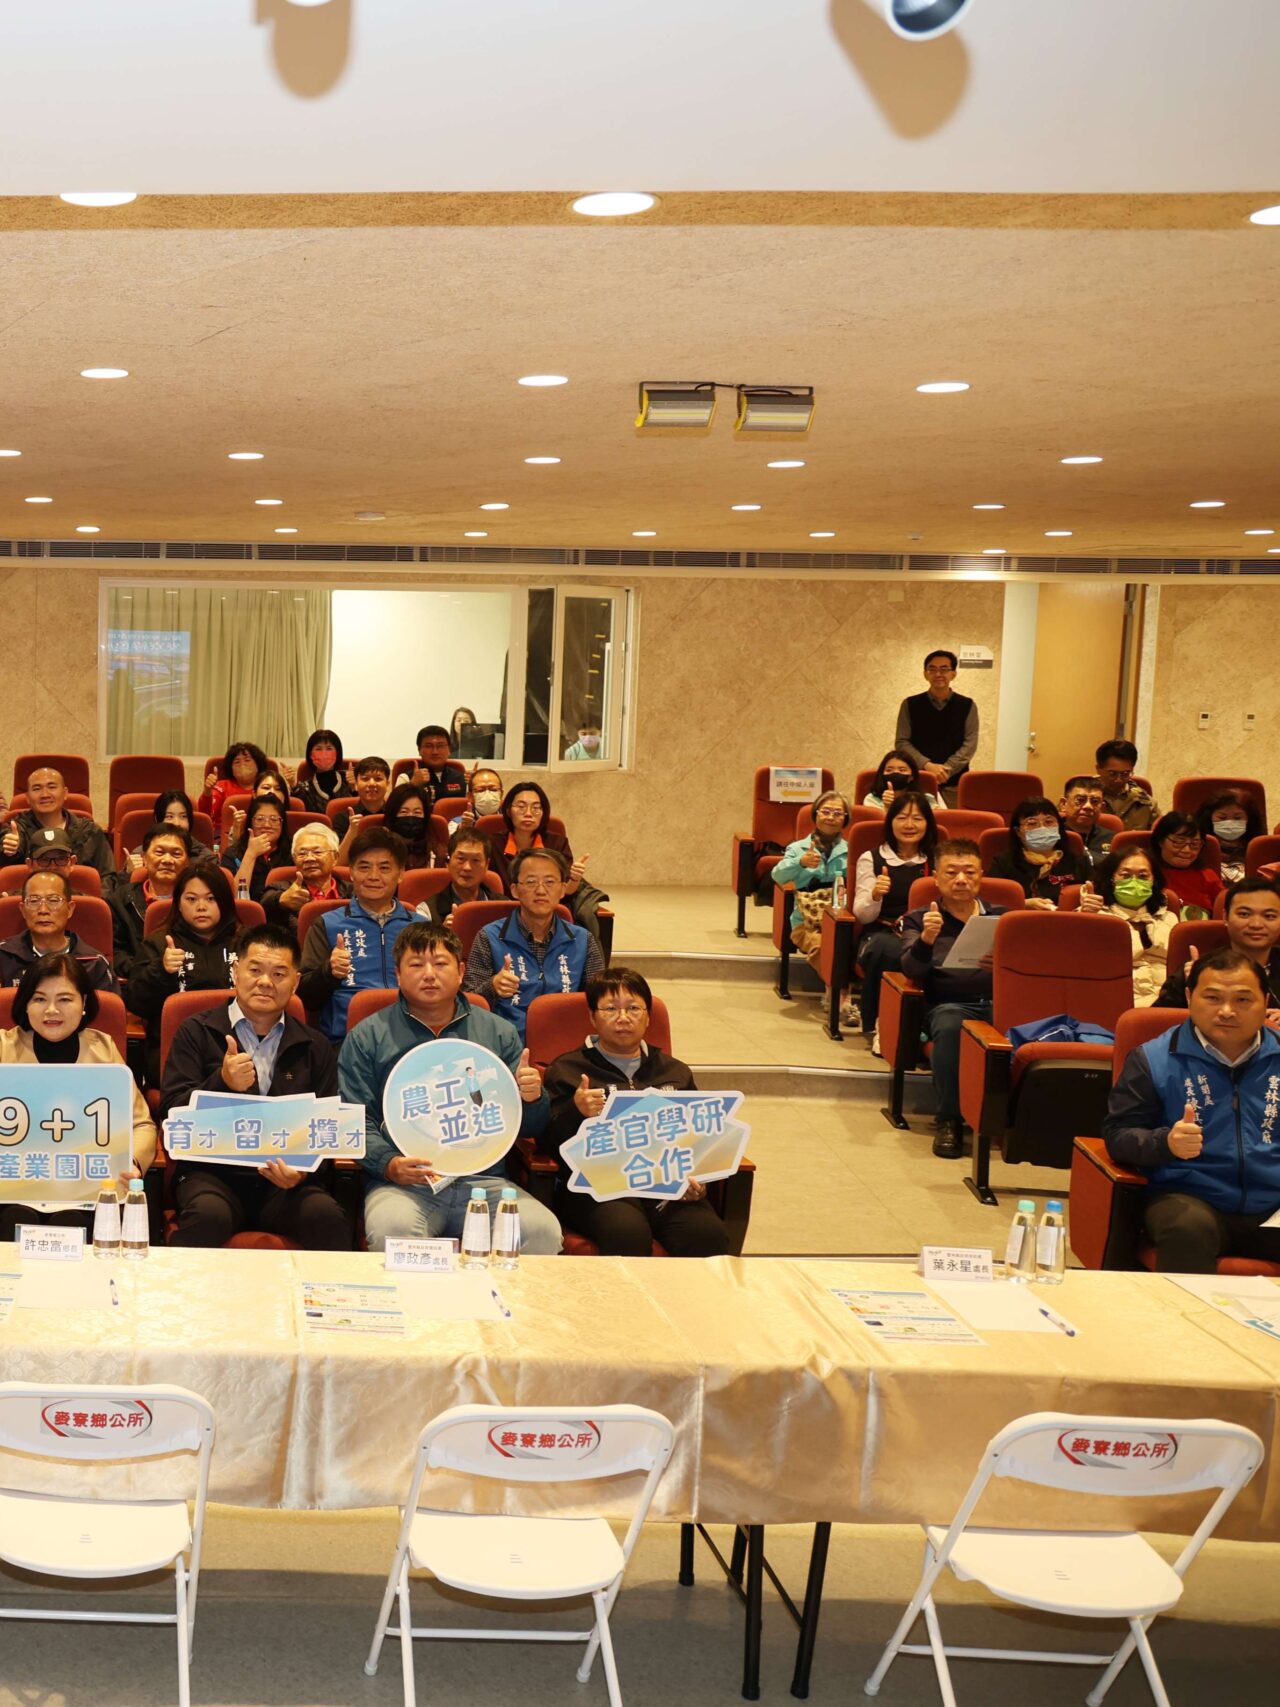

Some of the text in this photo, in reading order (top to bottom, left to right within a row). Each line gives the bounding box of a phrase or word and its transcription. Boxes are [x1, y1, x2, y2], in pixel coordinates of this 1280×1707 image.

[402, 1079, 465, 1119] 農工
[1261, 1075, 1280, 1144] 雲林縣政府
[439, 1103, 504, 1144] 並進
[585, 1100, 724, 1157] 產官學研
[623, 1147, 693, 1189] 合作
[54, 1411, 145, 1428] 麥寮鄉公所
[501, 1432, 593, 1448] 麥寮鄉公所
[1071, 1437, 1170, 1458] 麥寮鄉公所
